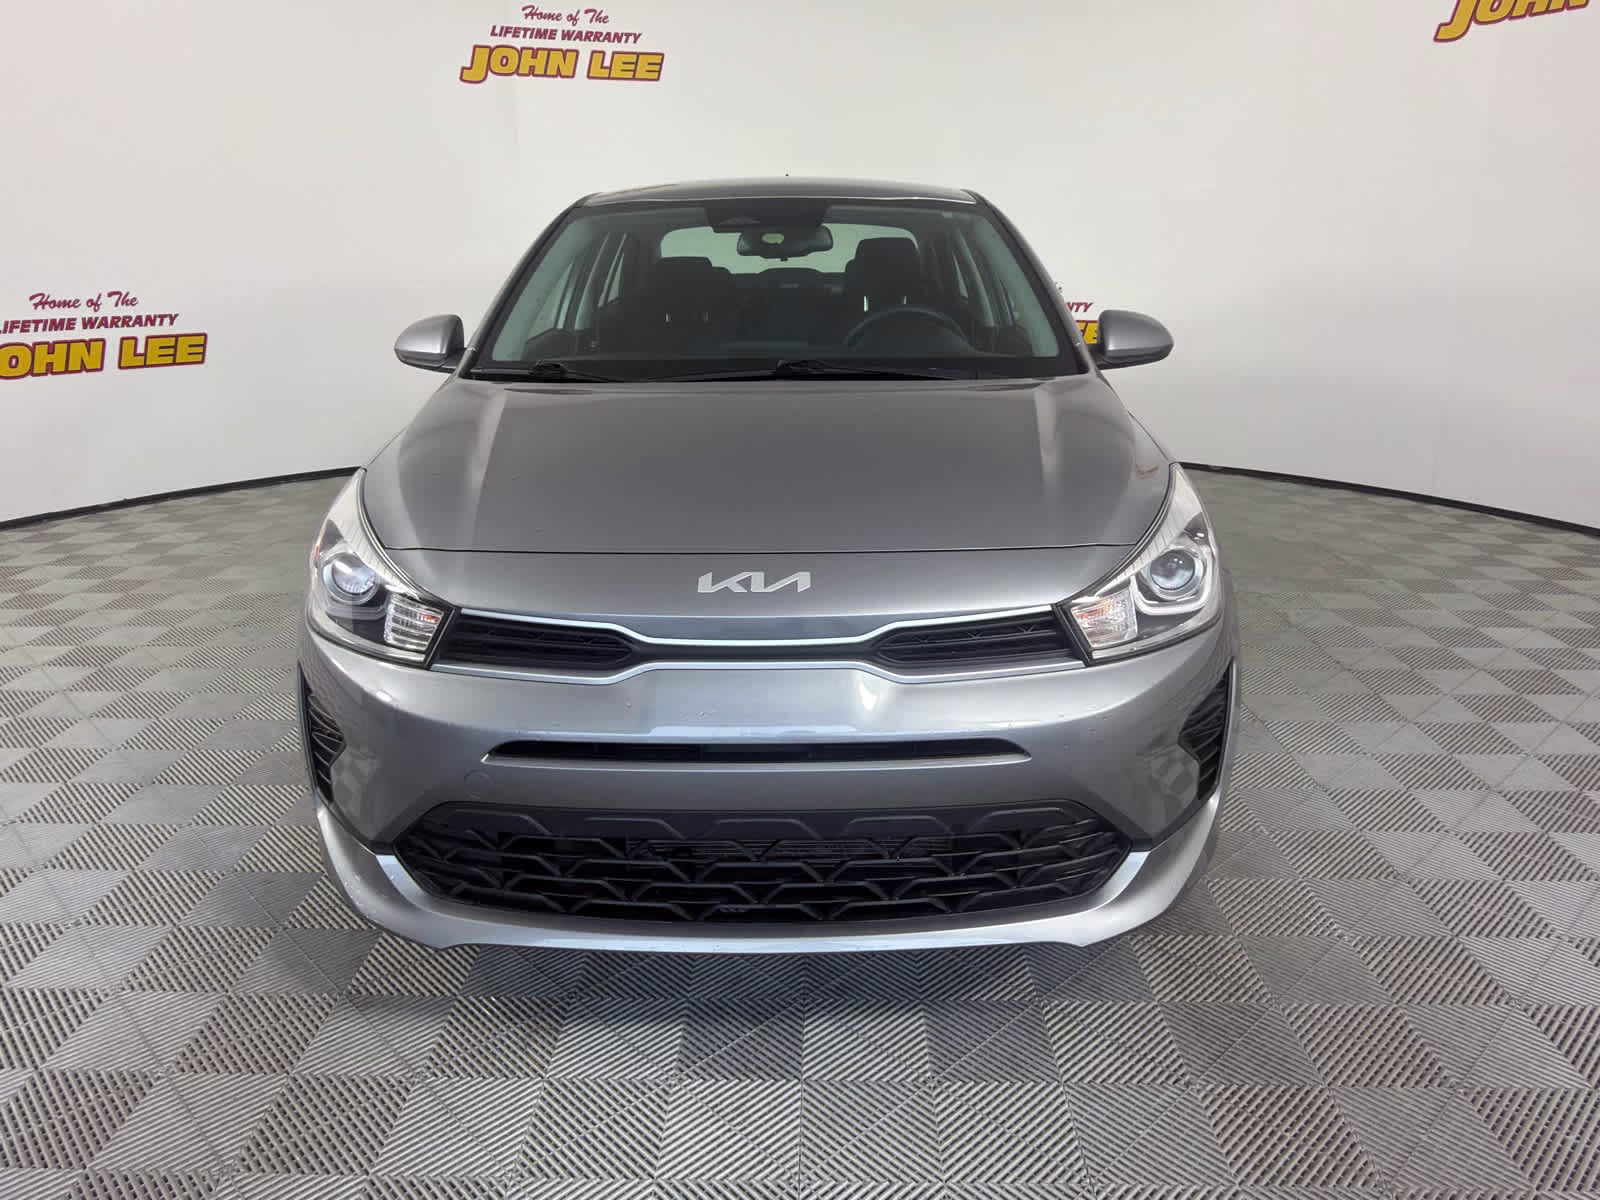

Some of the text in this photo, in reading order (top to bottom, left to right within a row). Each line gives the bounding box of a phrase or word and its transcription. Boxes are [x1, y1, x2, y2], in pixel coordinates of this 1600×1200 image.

[521, 4, 609, 26] Home of The
[490, 25, 642, 44] LIFETIME WARRANTY
[460, 45, 665, 83] JOHN LEE
[29, 291, 138, 312] Home of The
[0, 313, 179, 334] IFETIME WARRANTY
[0, 333, 207, 379] OHN LEE
